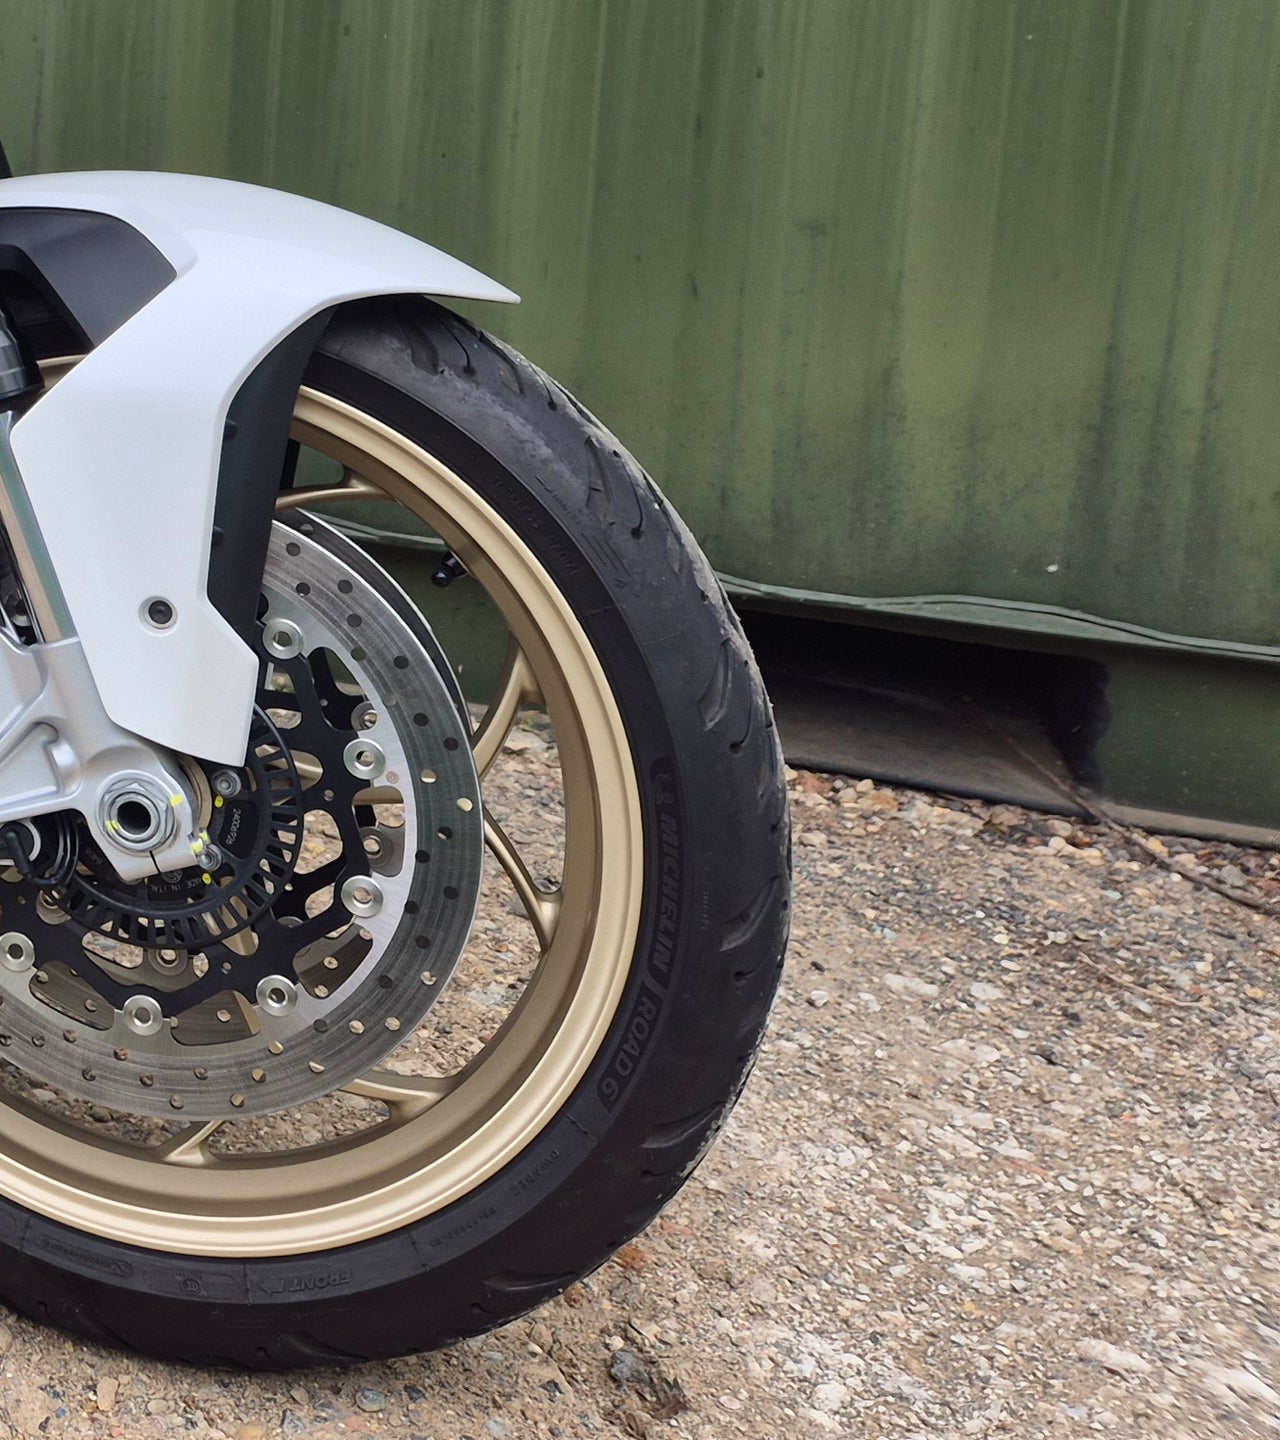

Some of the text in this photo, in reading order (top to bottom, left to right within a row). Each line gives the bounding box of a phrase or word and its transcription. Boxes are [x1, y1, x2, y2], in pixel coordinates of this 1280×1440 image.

[601, 812, 680, 1101] MICHELIN ROAD 6
[289, 1269, 353, 1292] FRONT
